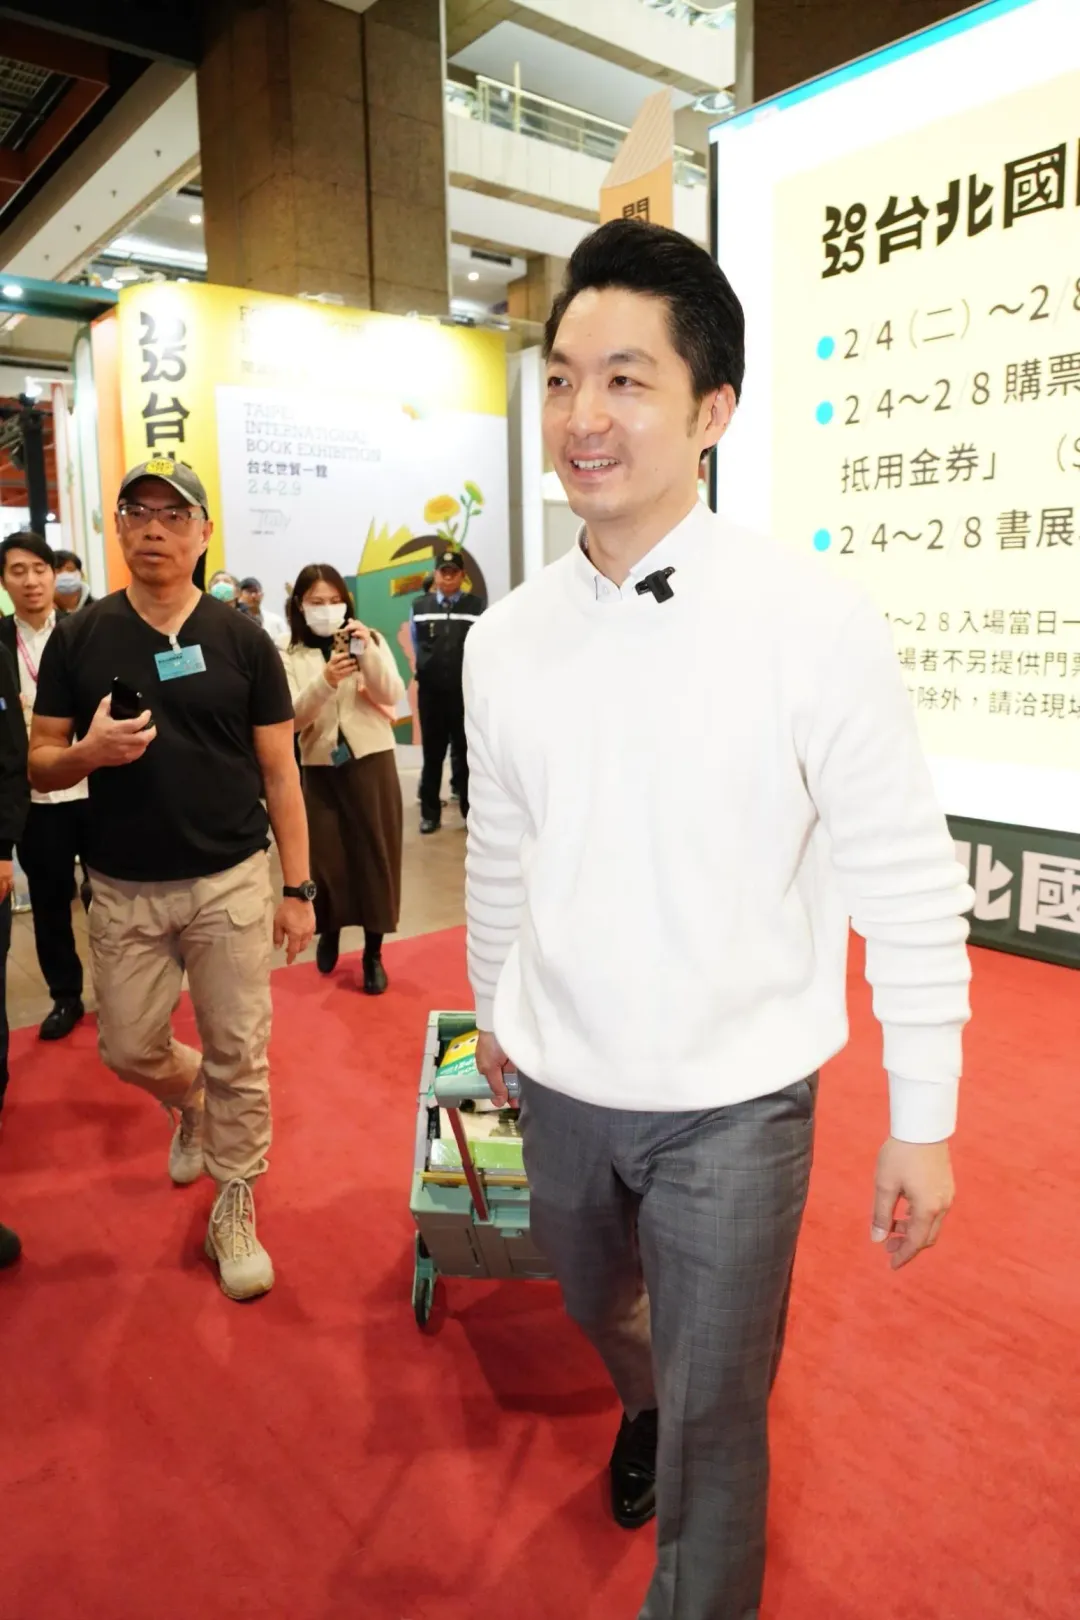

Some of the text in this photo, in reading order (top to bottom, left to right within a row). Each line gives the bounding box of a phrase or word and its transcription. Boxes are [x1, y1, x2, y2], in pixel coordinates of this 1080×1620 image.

[821, 140, 1080, 279] 2025台北國
[246, 438, 382, 462] BOOK EXHIBITION
[996, 507, 1080, 551] 書展
